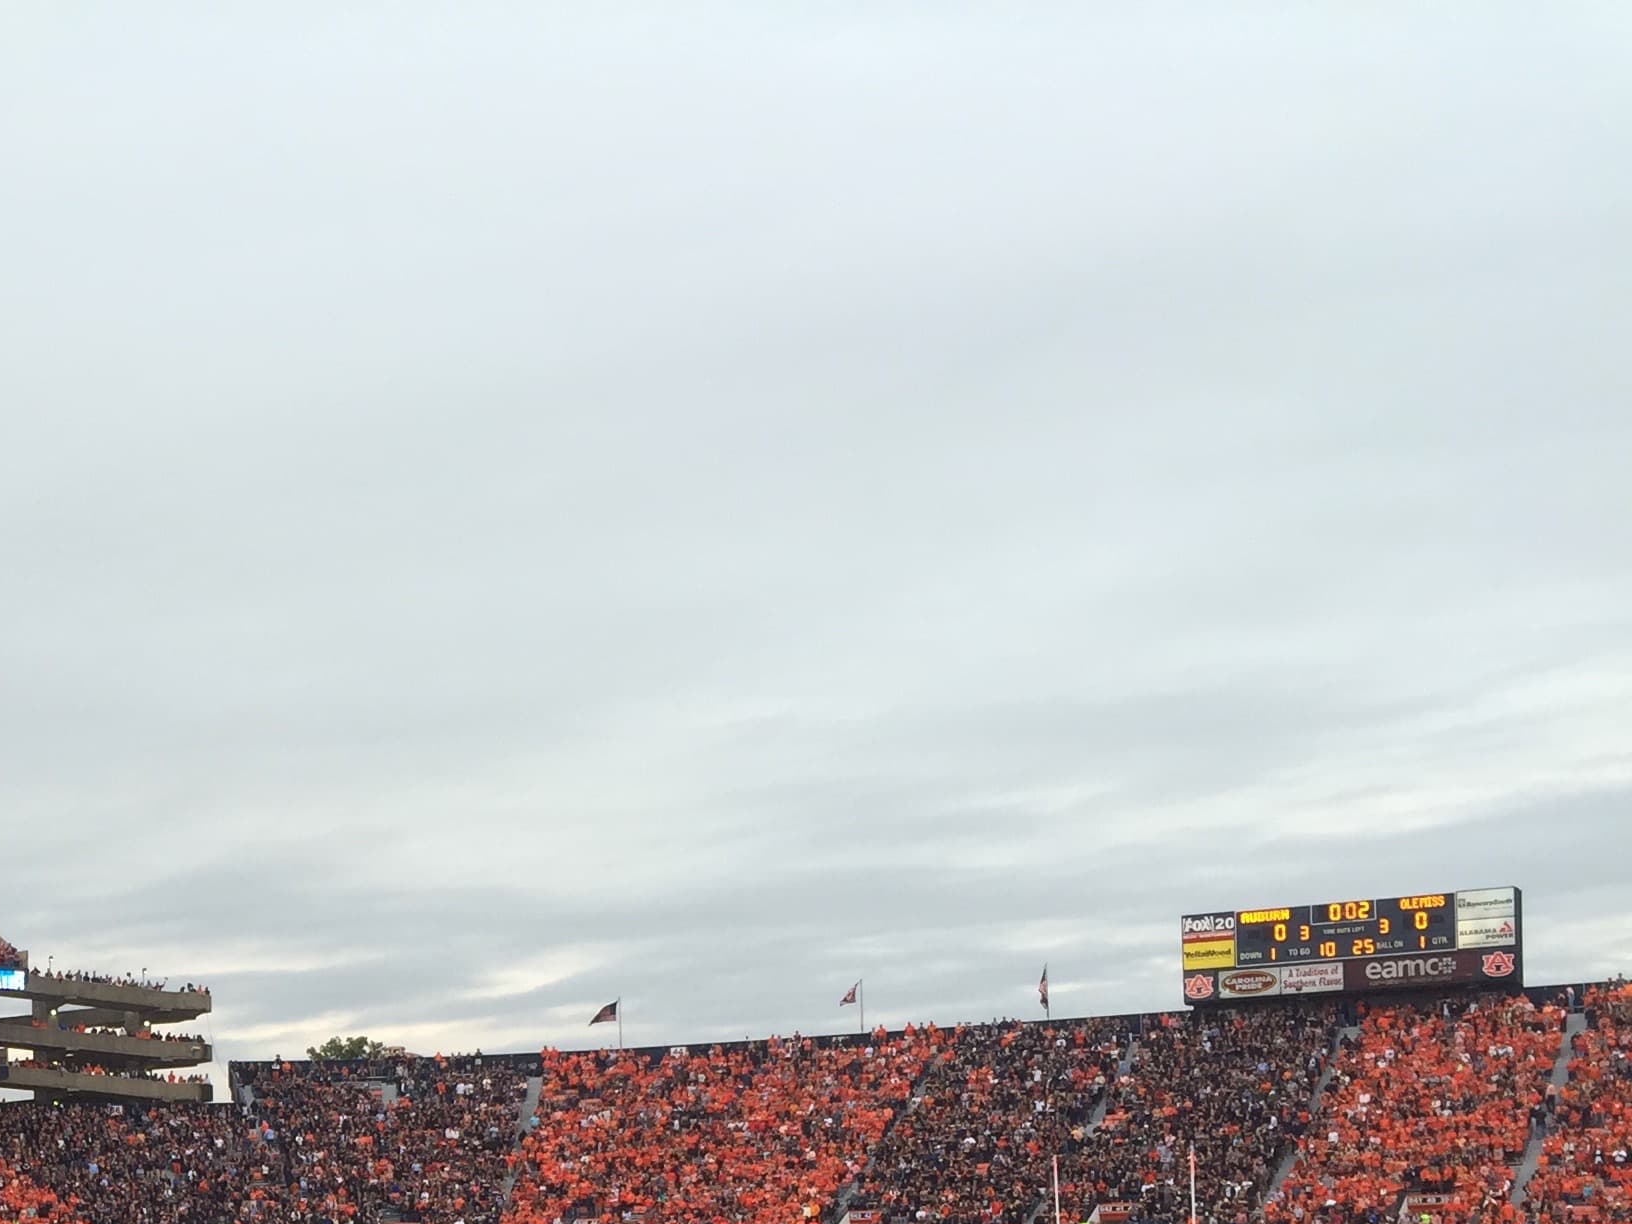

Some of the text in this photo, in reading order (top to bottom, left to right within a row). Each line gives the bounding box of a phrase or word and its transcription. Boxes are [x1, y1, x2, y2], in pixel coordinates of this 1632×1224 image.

[1215, 917, 1234, 930] 20
[1379, 918, 1390, 934] 3
[1414, 911, 1428, 930] 0
[1274, 923, 1287, 941] 0
[1299, 925, 1310, 941] 3
[1351, 938, 1375, 955] 25
[1419, 935, 1426, 949] 1
[1431, 936, 1448, 945] QTR
[1270, 947, 1277, 961] 1
[1288, 949, 1299, 957] TO
[1319, 941, 1337, 957] 10
[1365, 957, 1440, 980] eamc
